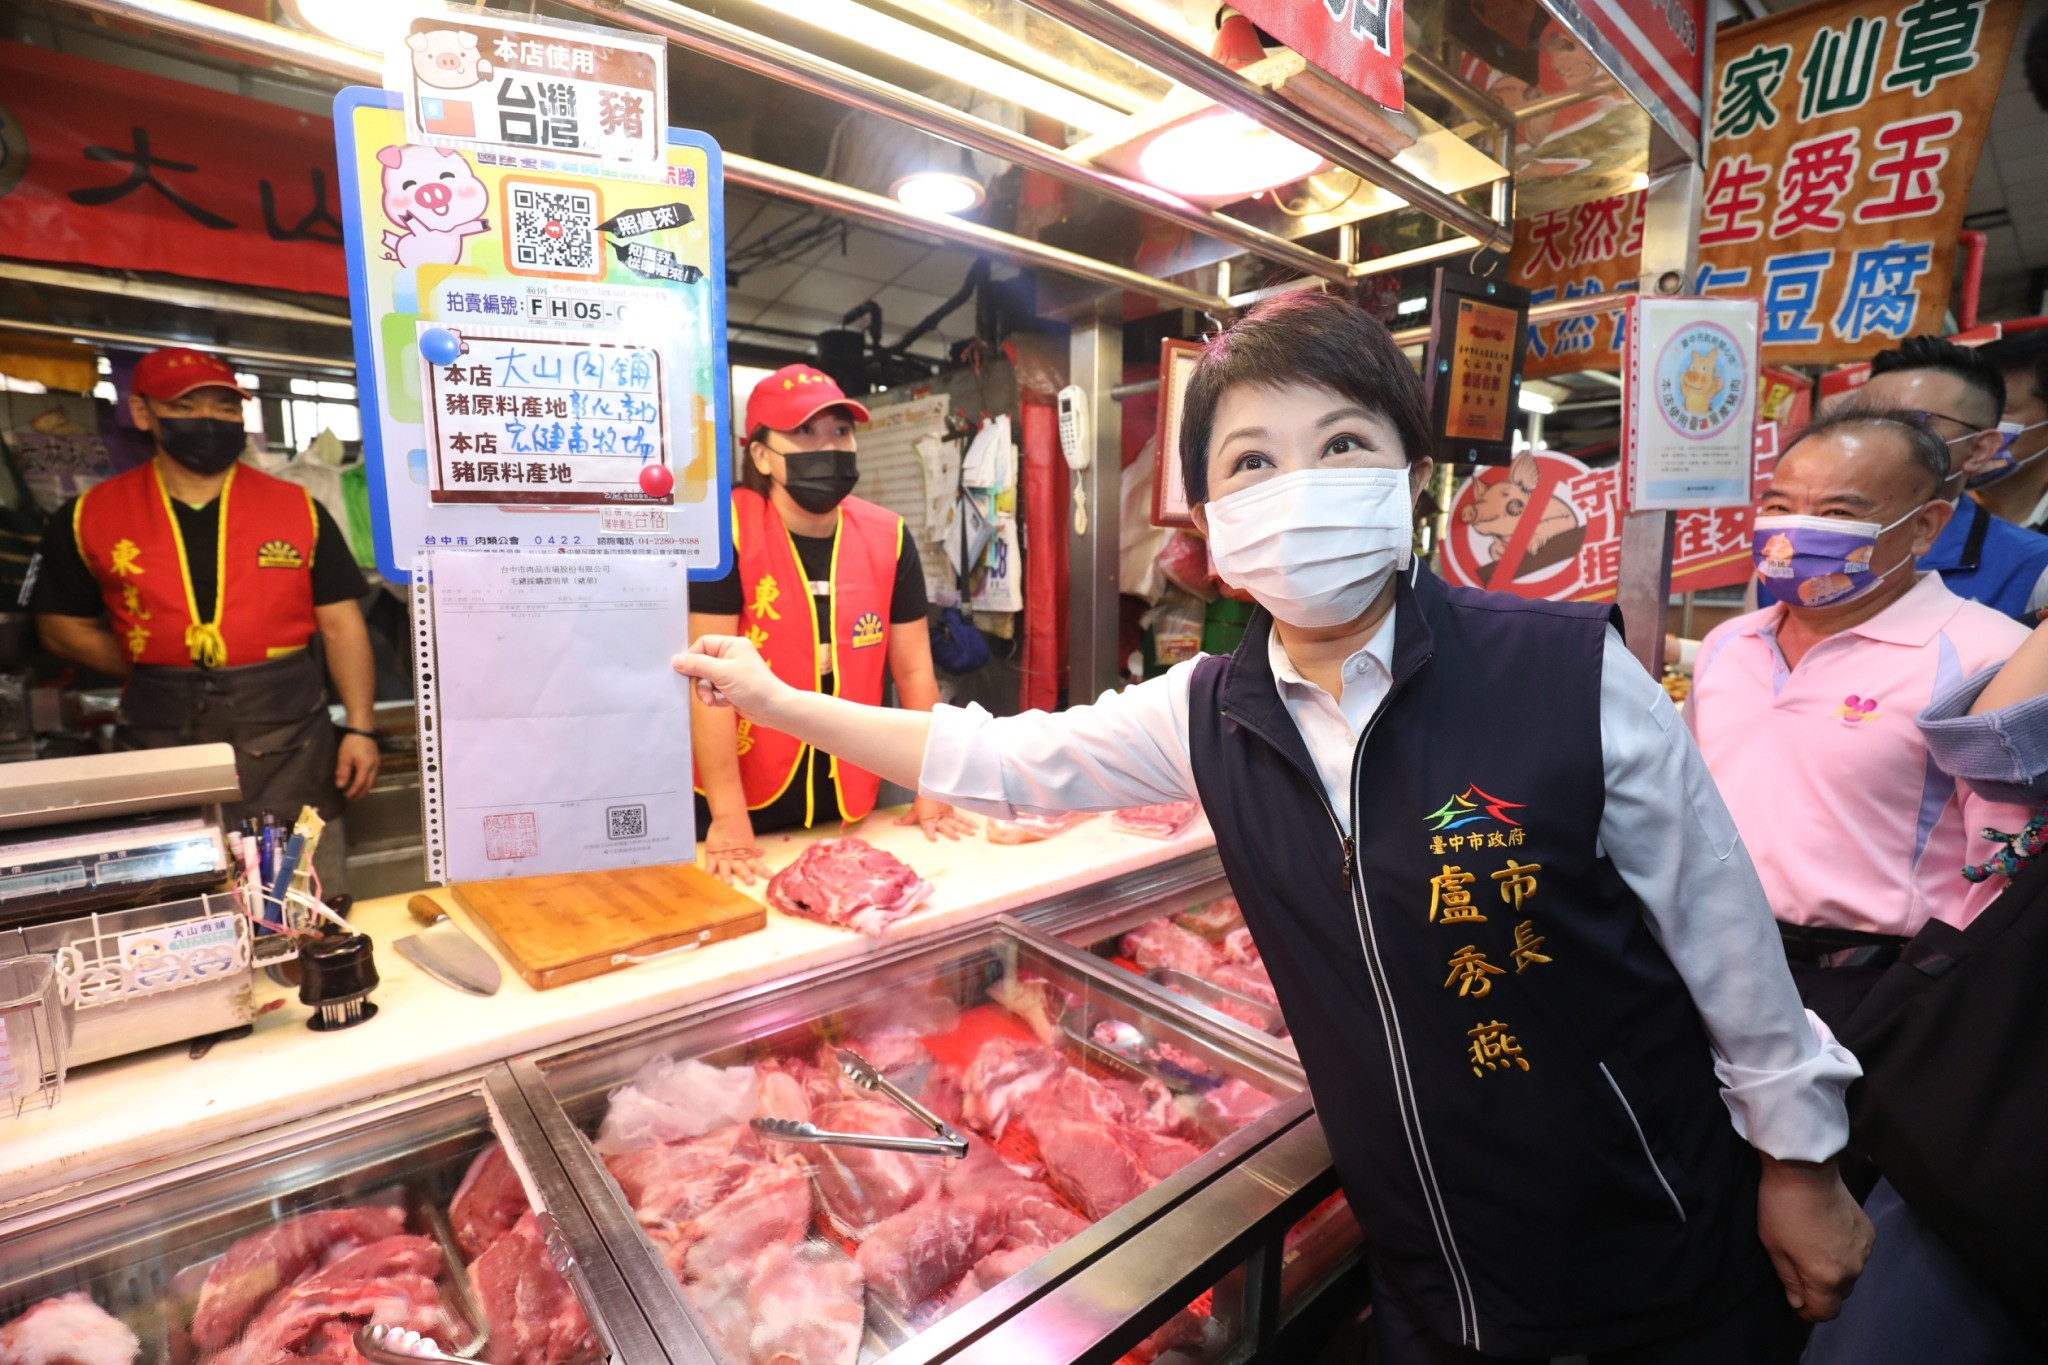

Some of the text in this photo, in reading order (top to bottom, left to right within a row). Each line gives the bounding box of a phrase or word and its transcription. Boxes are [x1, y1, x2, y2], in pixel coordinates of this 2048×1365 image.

[493, 36, 595, 75] 本店使用
[444, 363, 492, 387] 本店
[445, 393, 569, 419] 豬原料產地
[450, 432, 497, 455] 本店
[451, 461, 573, 484] 豬原料產地
[425, 535, 468, 545] 台中市
[1429, 827, 1526, 855] 臺中市政府
[1490, 859, 1553, 975] 市長
[1429, 864, 1530, 1078] 盧秀燕
